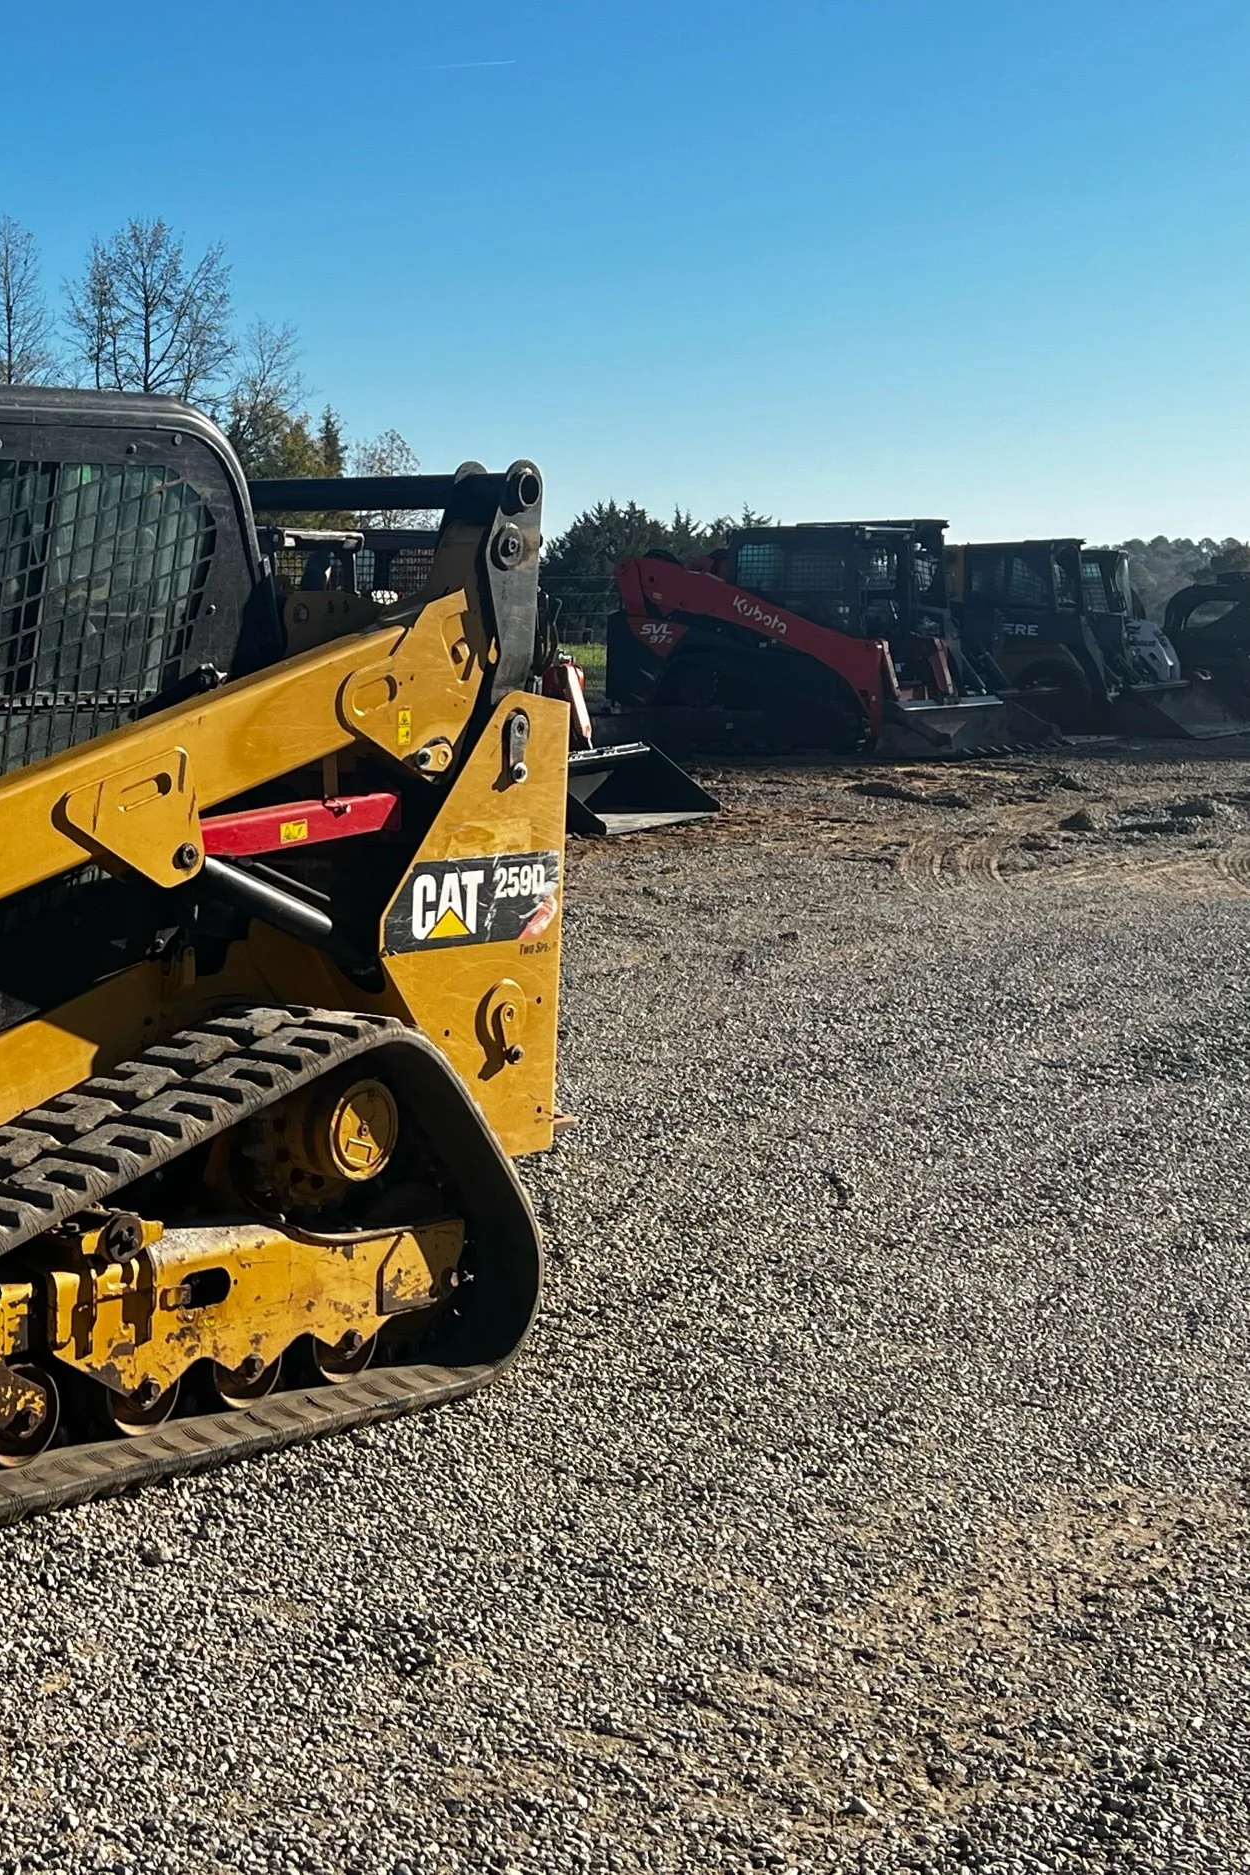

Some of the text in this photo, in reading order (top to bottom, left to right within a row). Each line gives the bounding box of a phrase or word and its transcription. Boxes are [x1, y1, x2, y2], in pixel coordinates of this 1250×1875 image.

[733, 594, 788, 635] Kubota
[639, 623, 673, 635] SVL
[1002, 622, 1039, 636] ERE
[411, 863, 547, 940] CAT 259D
